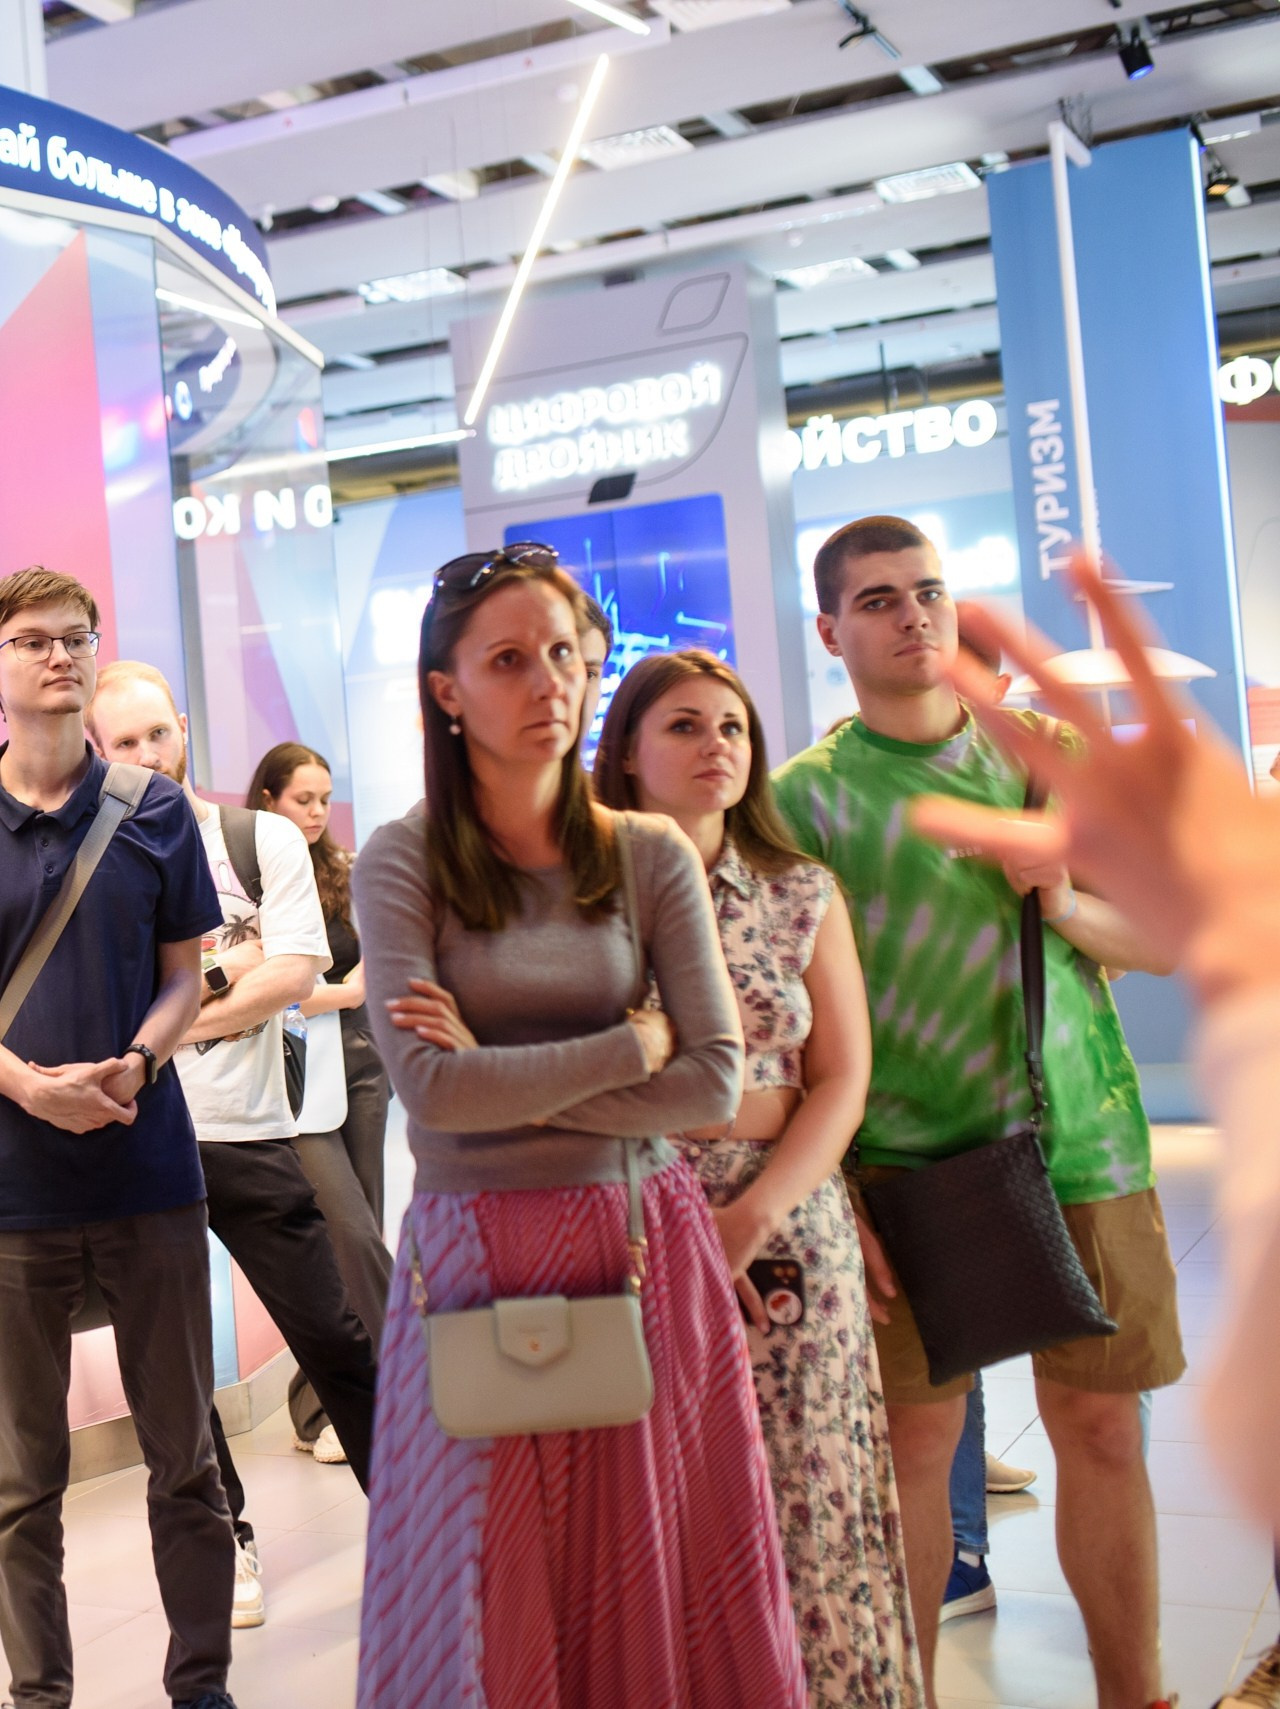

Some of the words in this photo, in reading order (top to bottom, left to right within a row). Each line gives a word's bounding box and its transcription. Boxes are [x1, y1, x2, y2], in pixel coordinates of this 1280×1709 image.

[46, 135, 158, 214] больше
[158, 187, 176, 223] в
[486, 361, 723, 446] ЦИФРОВОЙ
[491, 417, 691, 492] ДВОЙНИК
[1026, 398, 1073, 581] ТУРИЗМ
